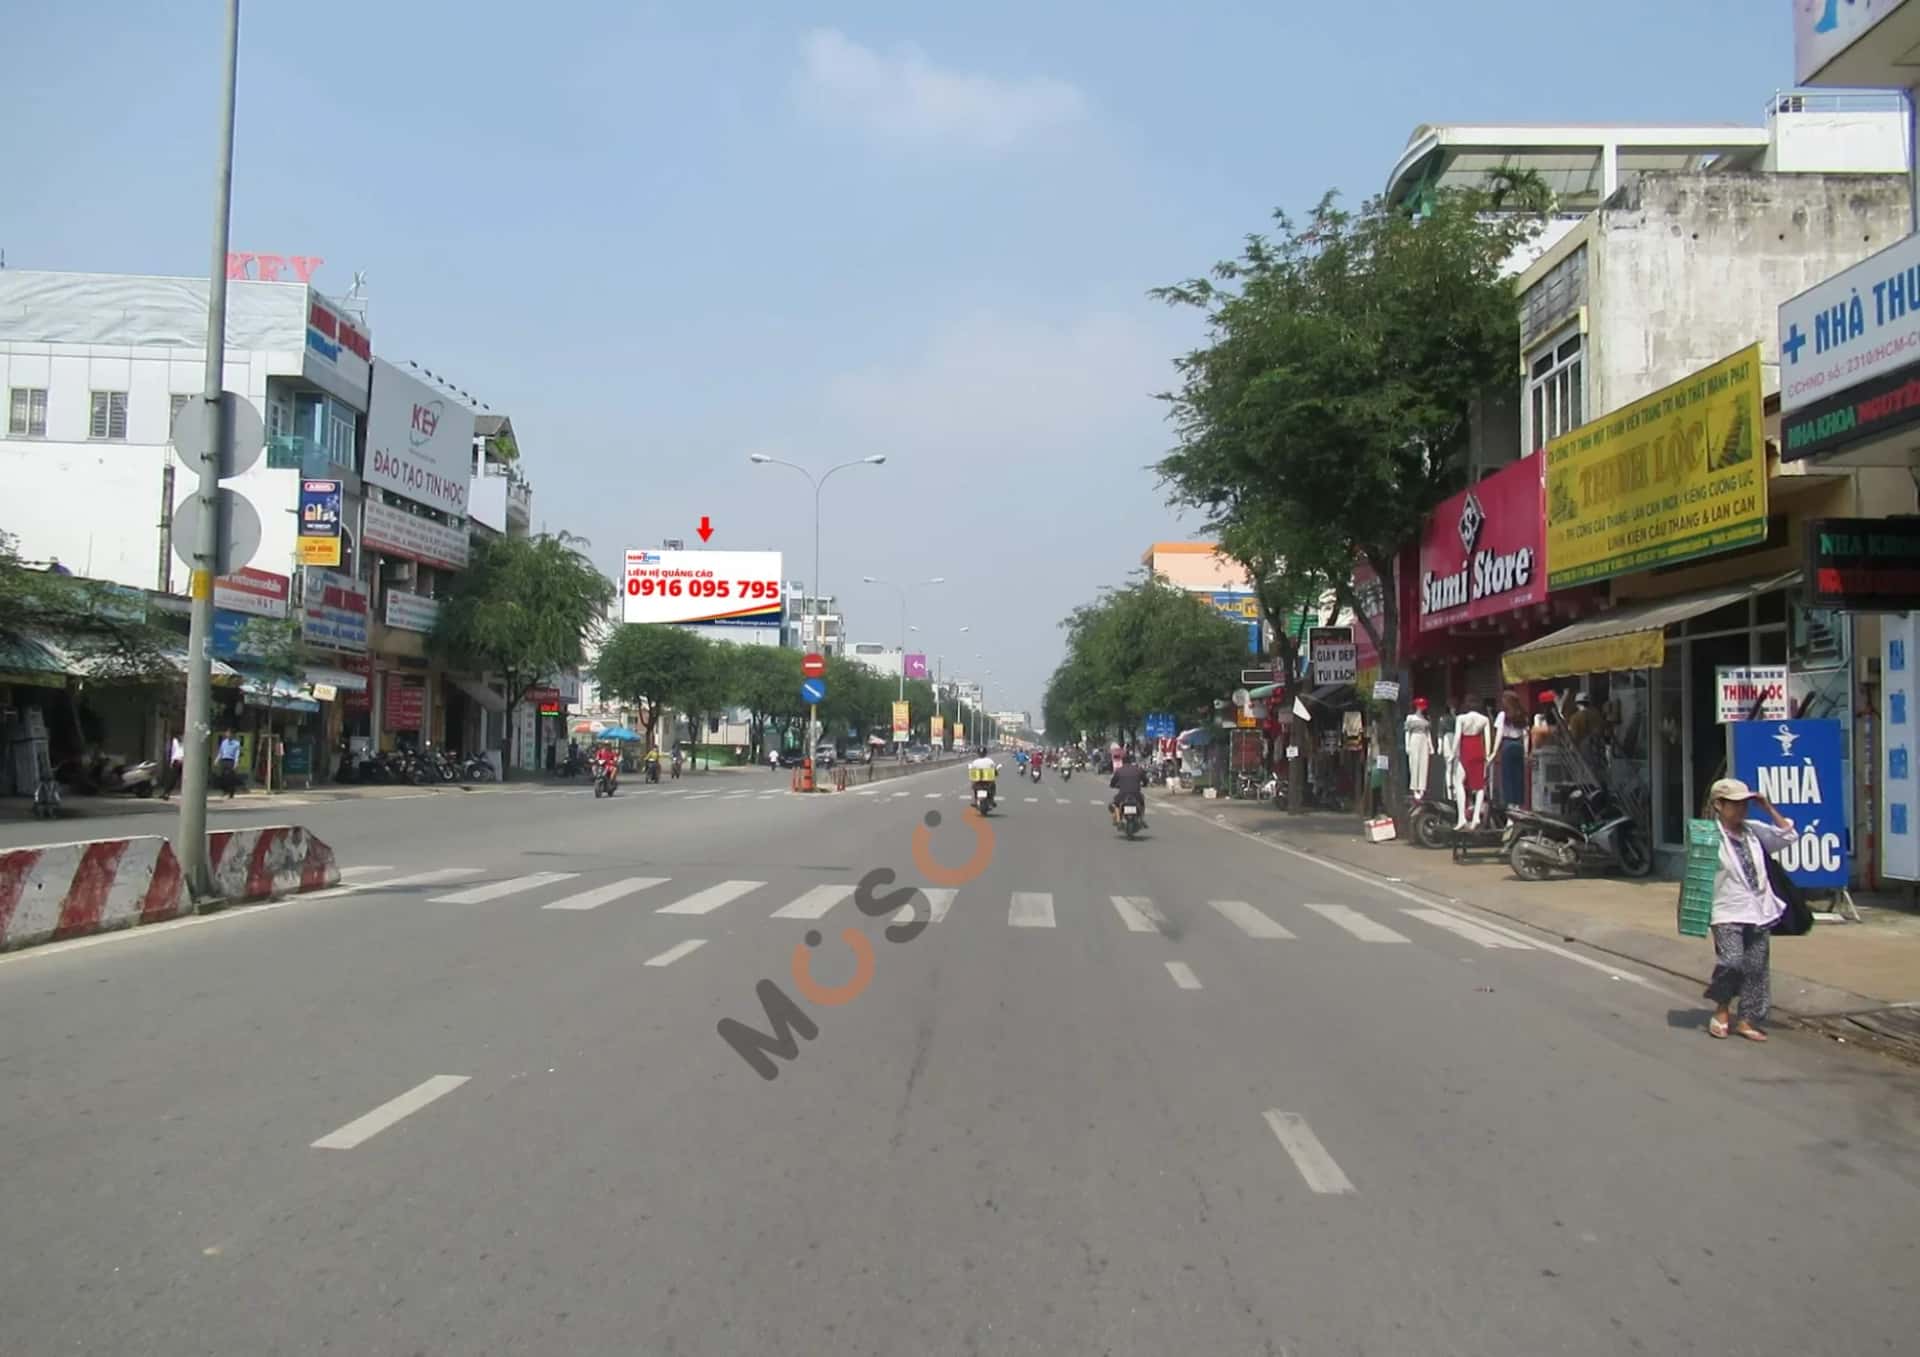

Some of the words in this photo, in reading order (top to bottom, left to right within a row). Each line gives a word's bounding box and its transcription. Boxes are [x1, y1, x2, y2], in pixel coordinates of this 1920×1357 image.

[1815, 287, 1864, 355] NHÀ
[1846, 328, 1920, 374] 2310/HCM-C
[411, 403, 440, 437] KEY
[402, 461, 424, 491] TẠO
[426, 472, 441, 498] TIN
[442, 479, 465, 506] HỌC
[1668, 510, 1700, 534] THANG
[1702, 507, 1709, 525] &
[1712, 501, 1731, 521] LAN
[1733, 495, 1756, 516] CAN
[627, 578, 682, 597] 0916
[688, 579, 730, 598] 095
[737, 580, 779, 599] 795
[628, 568, 647, 577] LIÊN
[649, 568, 660, 578] HỆ
[662, 568, 694, 578] QUẢNG
[695, 568, 713, 578] CÁO
[1421, 560, 1469, 616] Sumi
[1473, 547, 1530, 600] Store
[1723, 684, 1758, 704] THỊNH
[1757, 757, 1822, 804] NHÀ
[1771, 818, 1841, 872] UỐC
